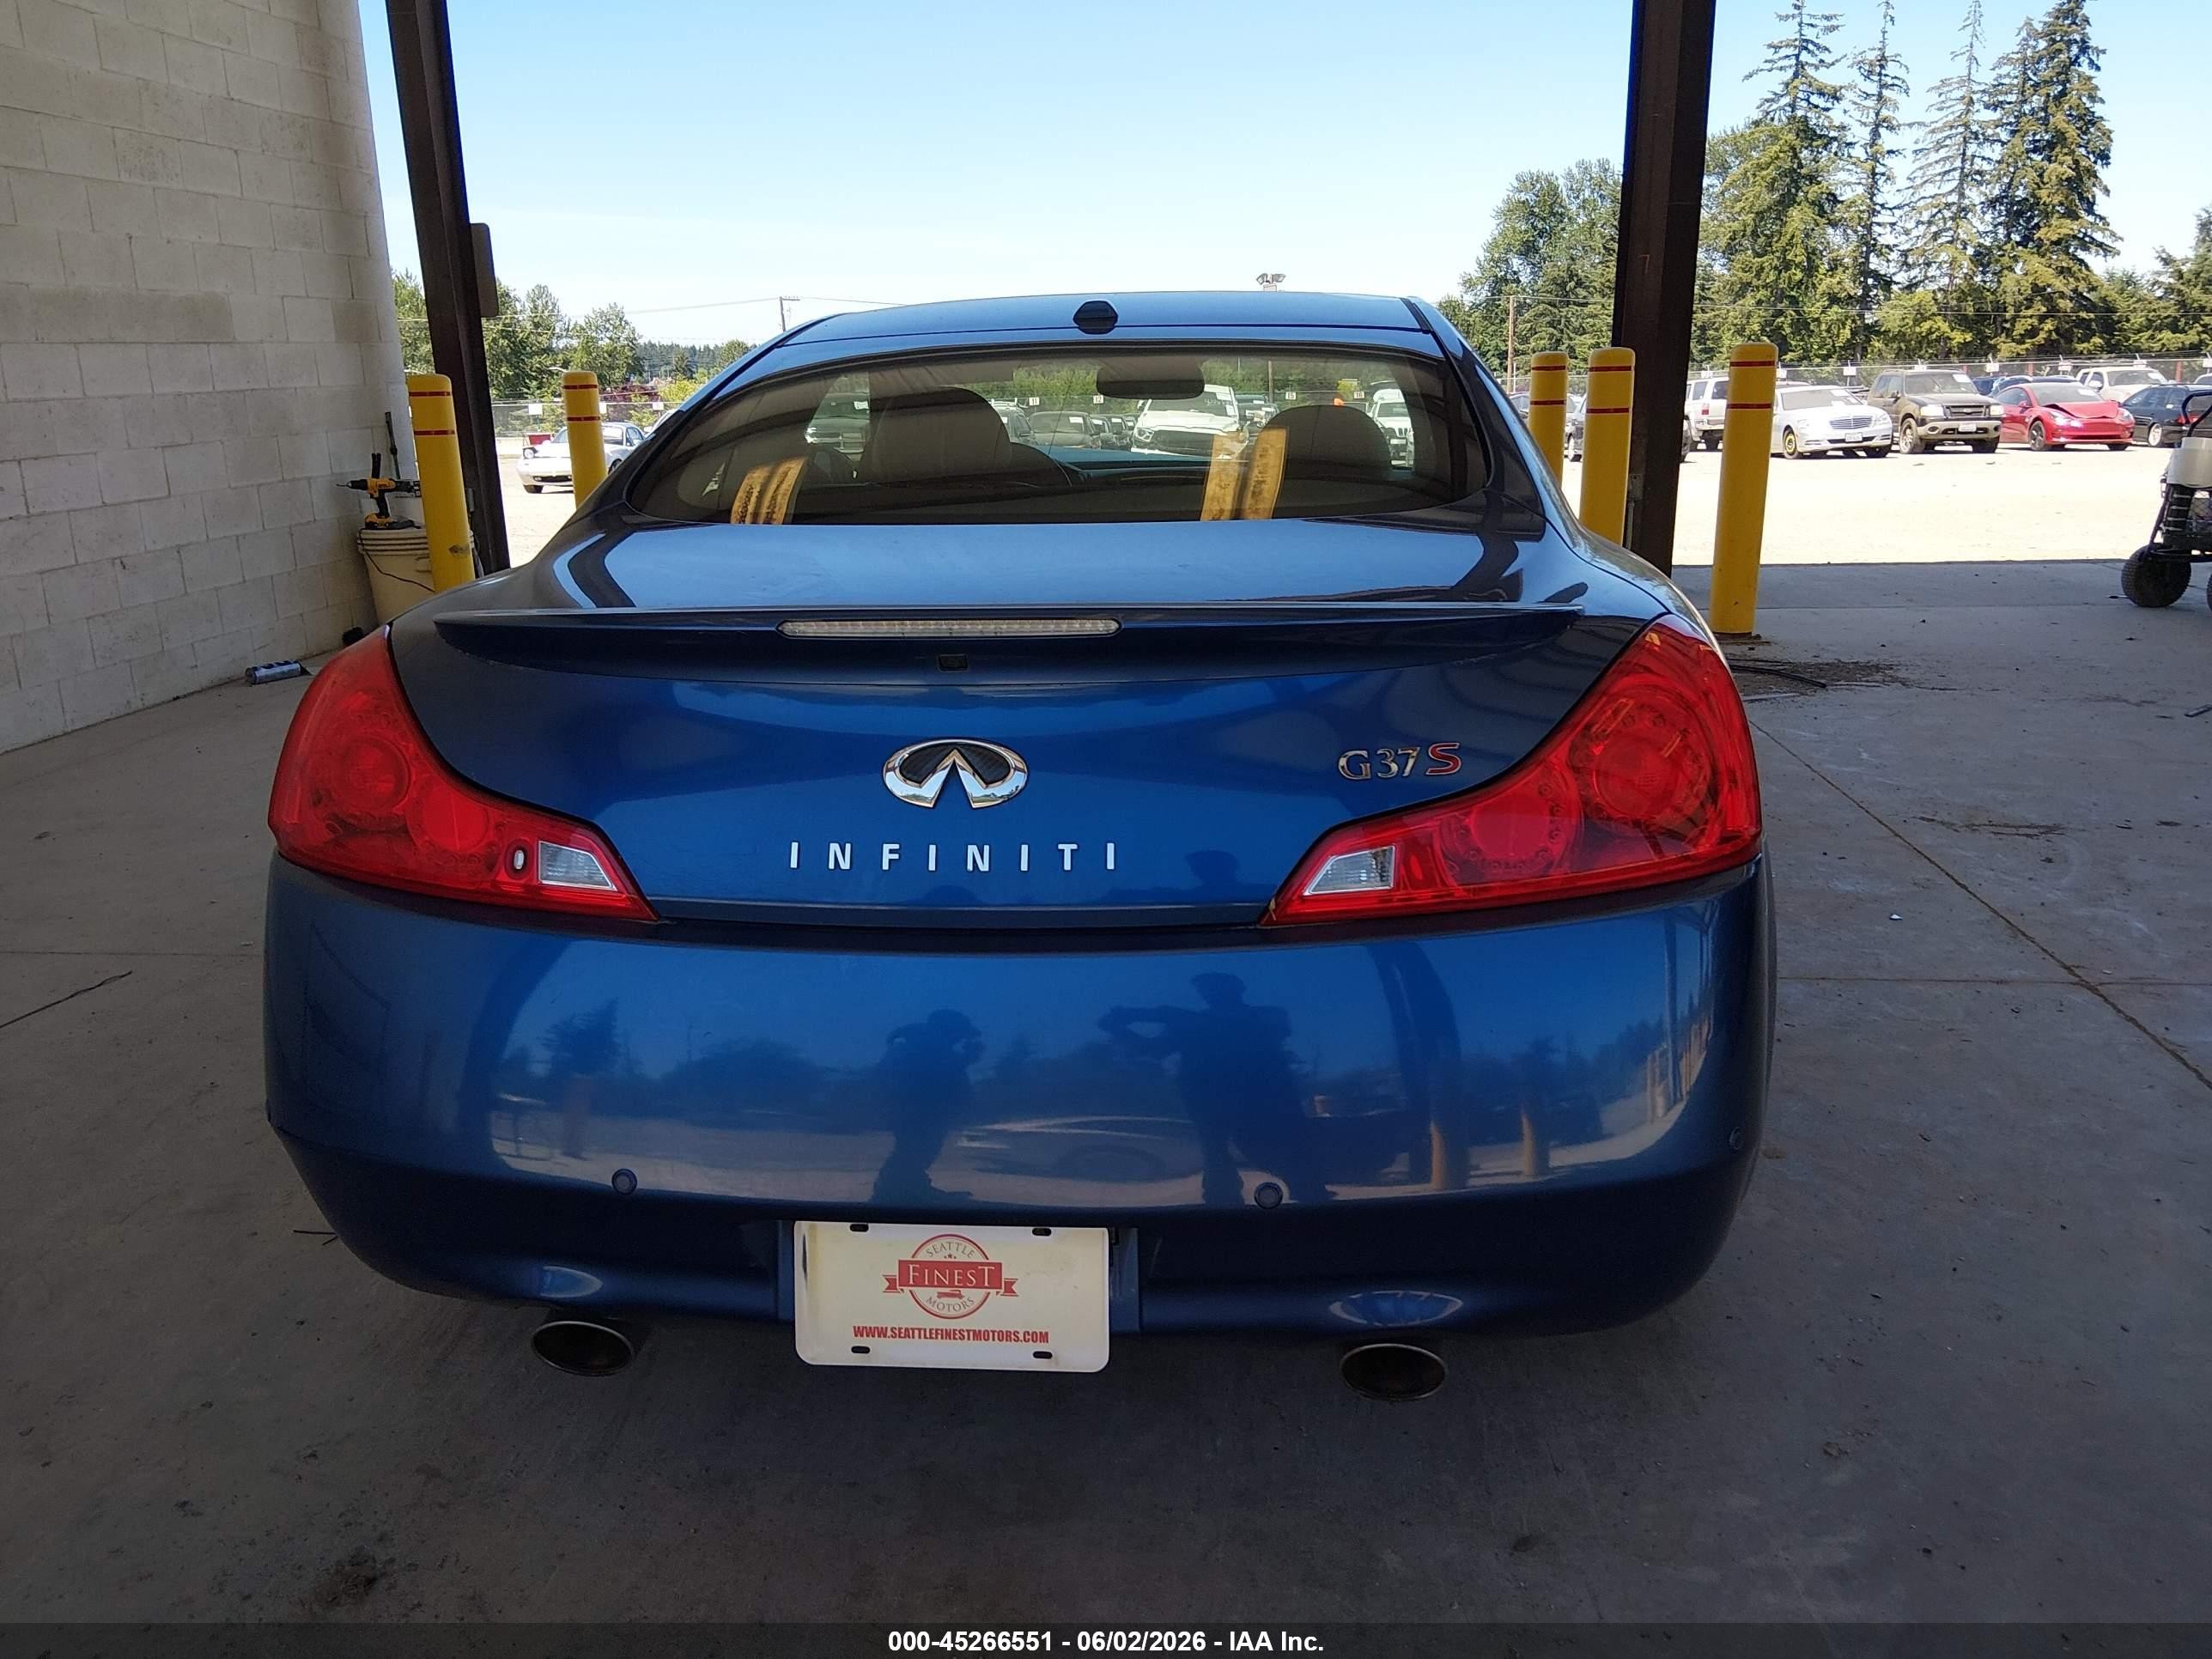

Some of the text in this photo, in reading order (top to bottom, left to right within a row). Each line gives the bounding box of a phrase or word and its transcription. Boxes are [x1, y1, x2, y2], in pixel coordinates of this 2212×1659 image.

[789, 842, 1115, 872] INFINITI
[926, 1241, 975, 1258] SEATTLE
[908, 1264, 995, 1287] FINEST
[927, 1296, 975, 1313] MOTORS
[853, 1325, 1049, 1344] WWW.SEATTLEFINESTMOTORS.COM
